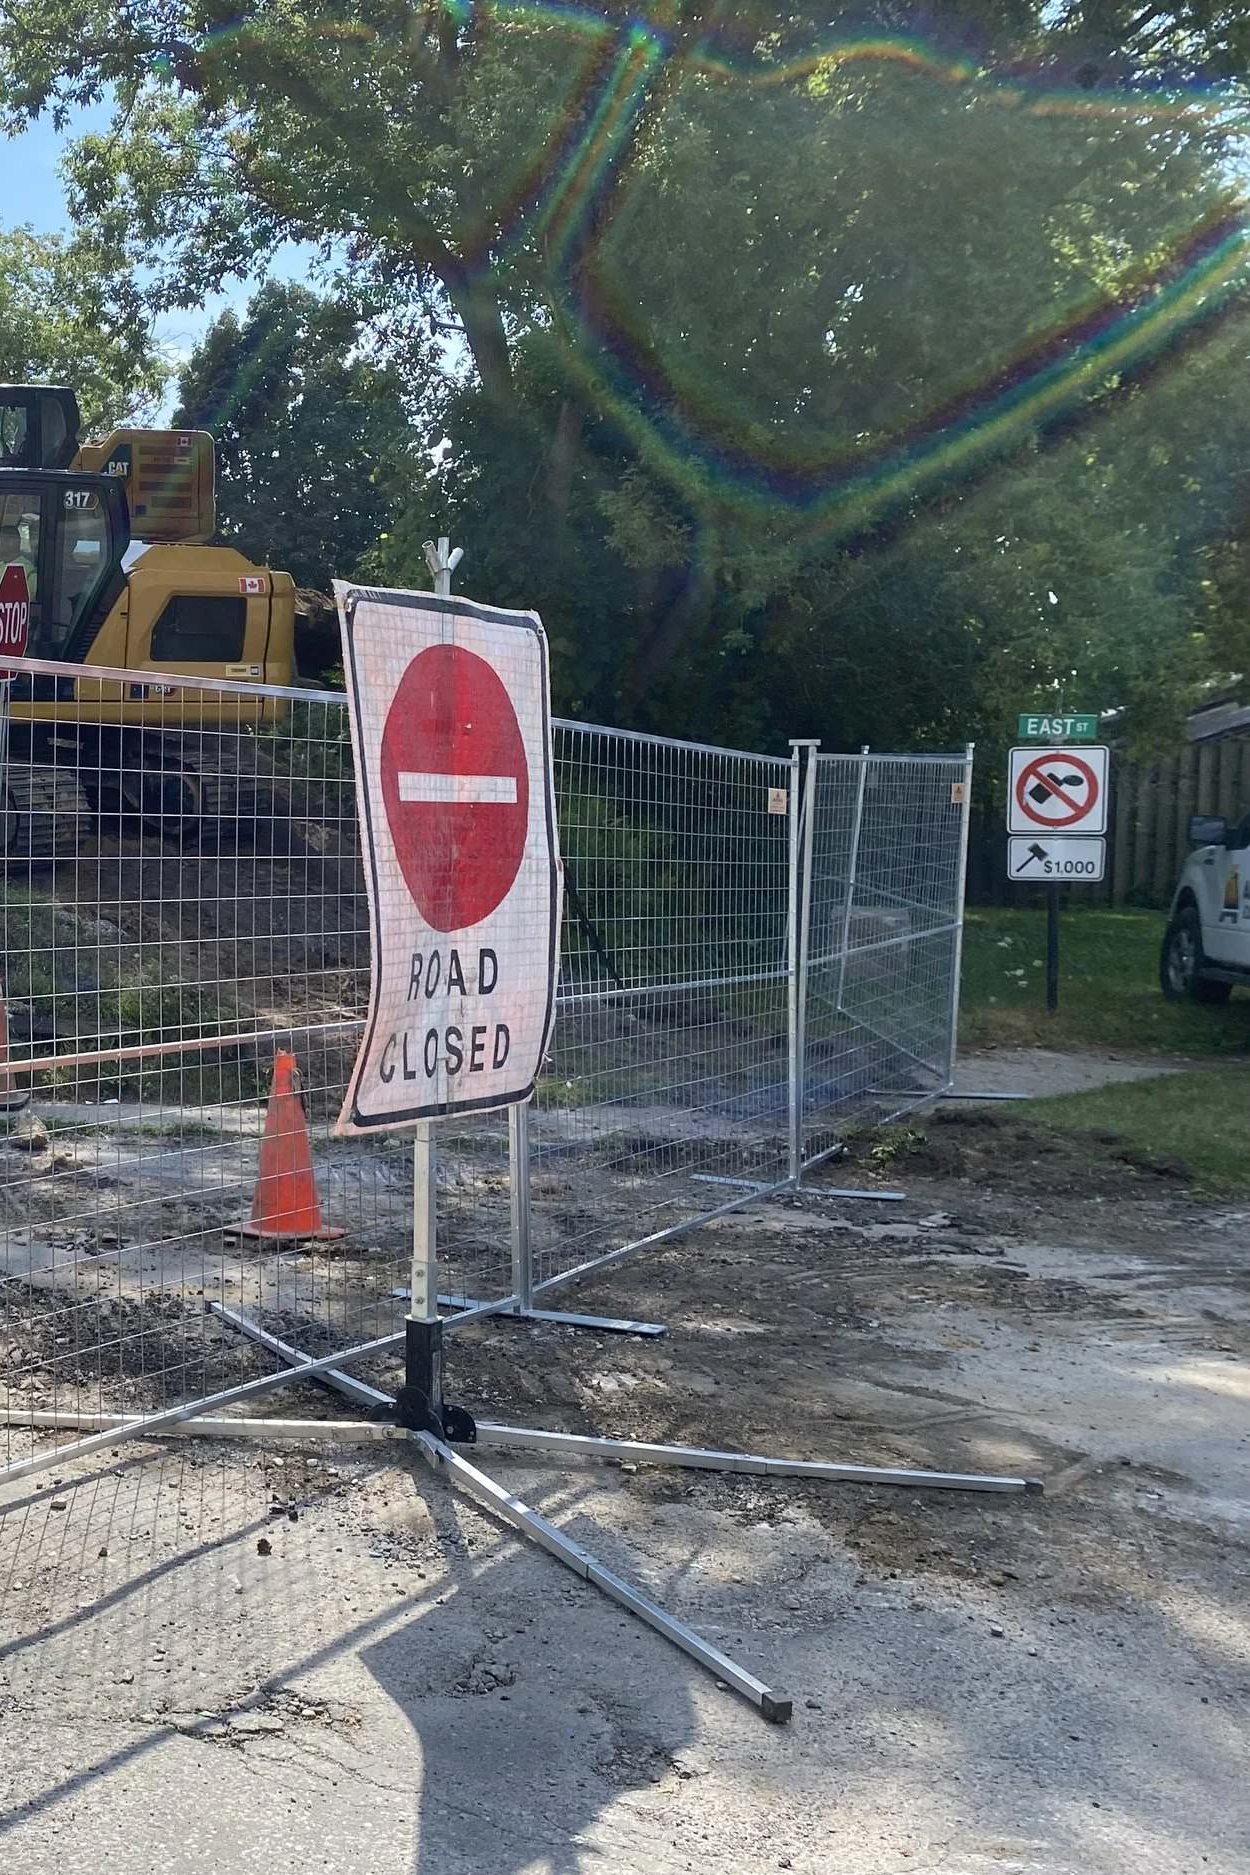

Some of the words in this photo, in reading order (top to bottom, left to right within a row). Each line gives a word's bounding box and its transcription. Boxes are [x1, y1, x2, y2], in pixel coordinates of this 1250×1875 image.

[108, 461, 129, 476] CAT
[65, 490, 90, 507] 317
[1027, 718, 1075, 735] EAST
[1076, 722, 1089, 732] ST
[1043, 860, 1096, 876] $1,000
[407, 948, 499, 1002] ROAD
[379, 1023, 511, 1084] CLOSED
